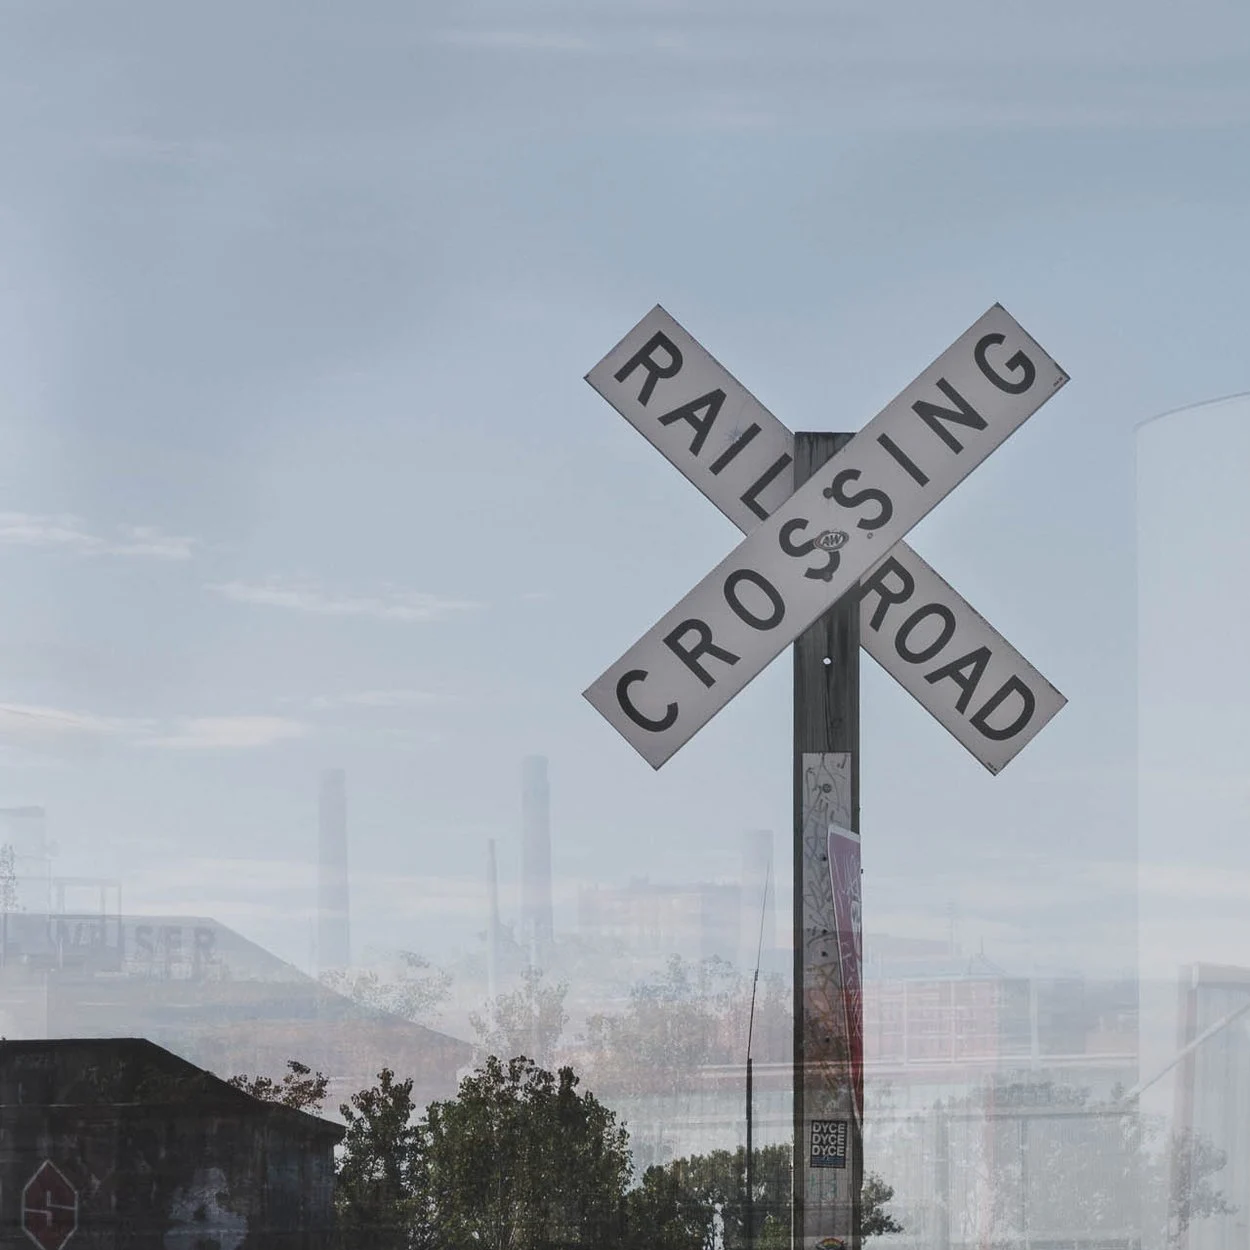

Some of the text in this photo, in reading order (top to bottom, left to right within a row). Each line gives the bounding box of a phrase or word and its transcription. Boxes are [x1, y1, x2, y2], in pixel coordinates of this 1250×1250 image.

[613, 330, 1036, 741] RAIL ROAD
[616, 332, 1036, 733] CROSSING
[812, 1122, 845, 1134] DYCE
[812, 1133, 845, 1146] DYCE
[811, 1144, 845, 1157] DYCE
